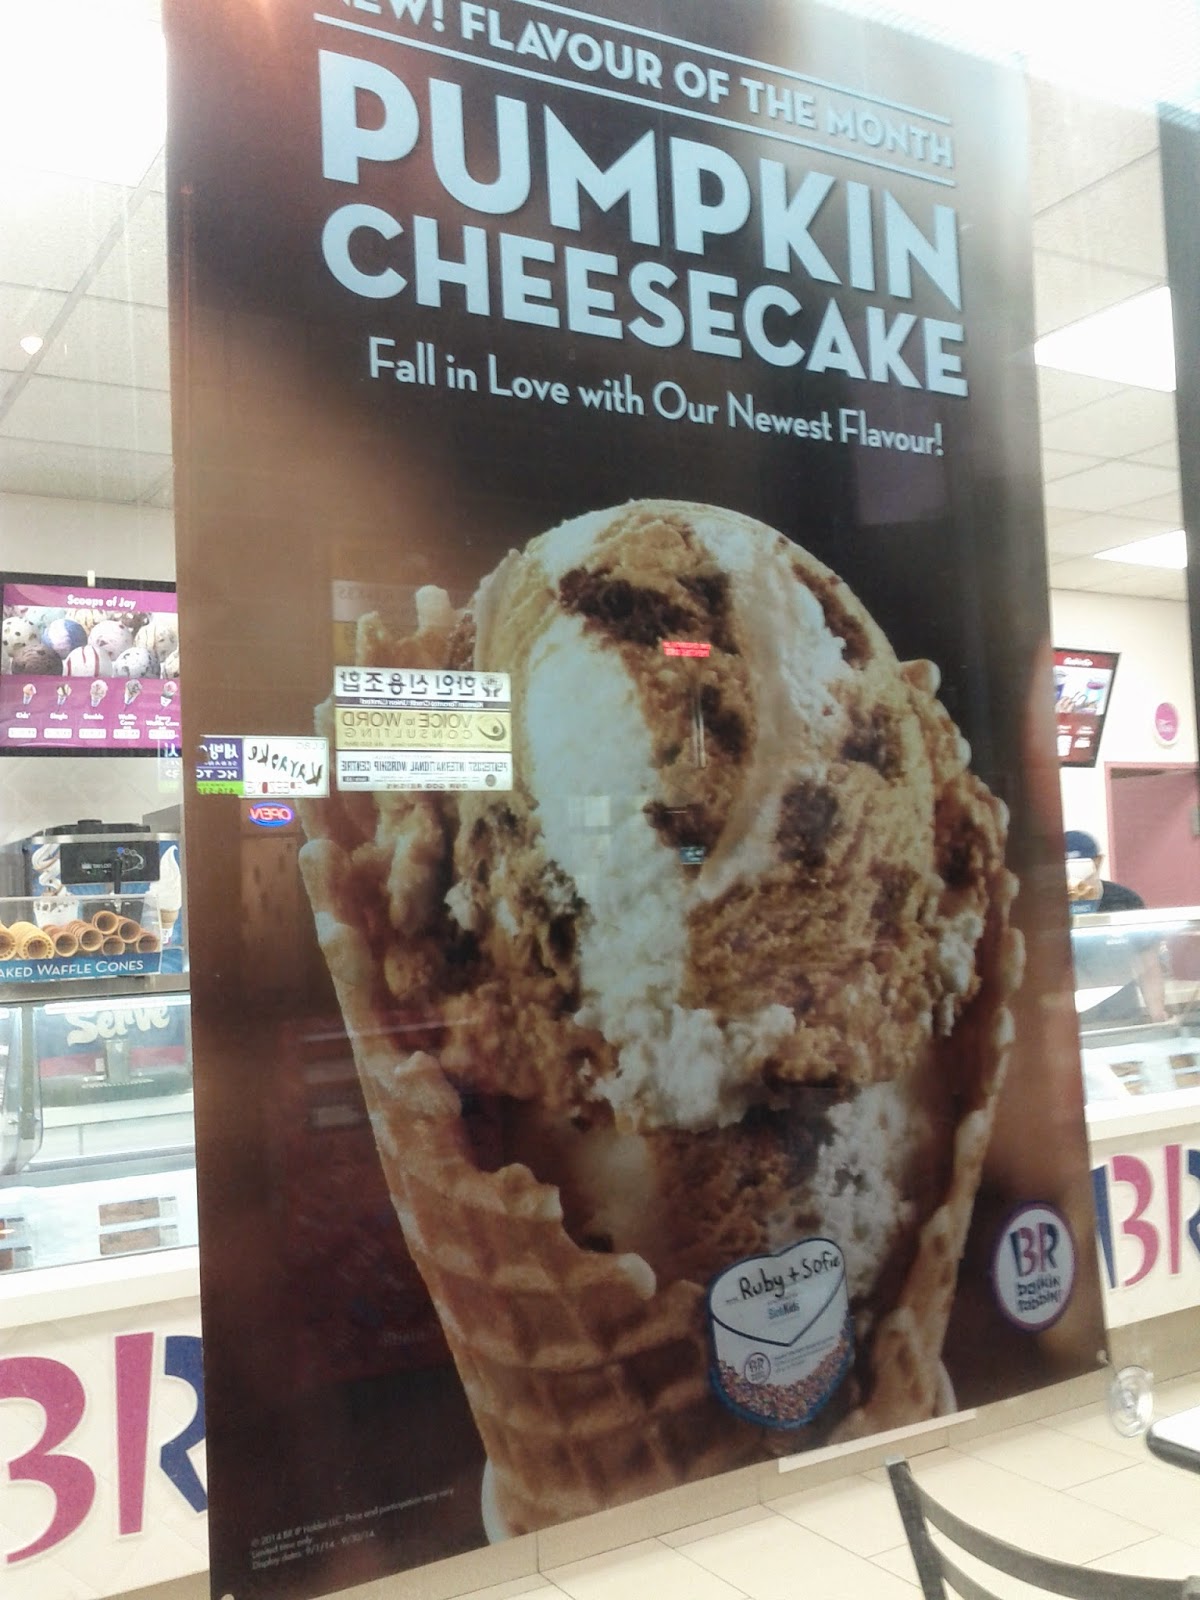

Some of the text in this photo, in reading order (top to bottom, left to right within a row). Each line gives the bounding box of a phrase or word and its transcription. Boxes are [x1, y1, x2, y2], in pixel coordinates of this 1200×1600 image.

[343, 0, 954, 169] W! FLAVOUR OF THE MONTH
[318, 49, 962, 312] PUMPKIN
[322, 203, 968, 398] CHEESECAKE
[369, 337, 944, 457] Fall in Love with Our Newest Flavour!
[67, 594, 137, 610] Scoops of Joy
[36, 964, 92, 976] WAFFLE
[95, 960, 144, 973] CONES
[66, 1005, 171, 1047] Serve
[1010, 1222, 1059, 1277] BR
[739, 1268, 785, 1300] Ruby
